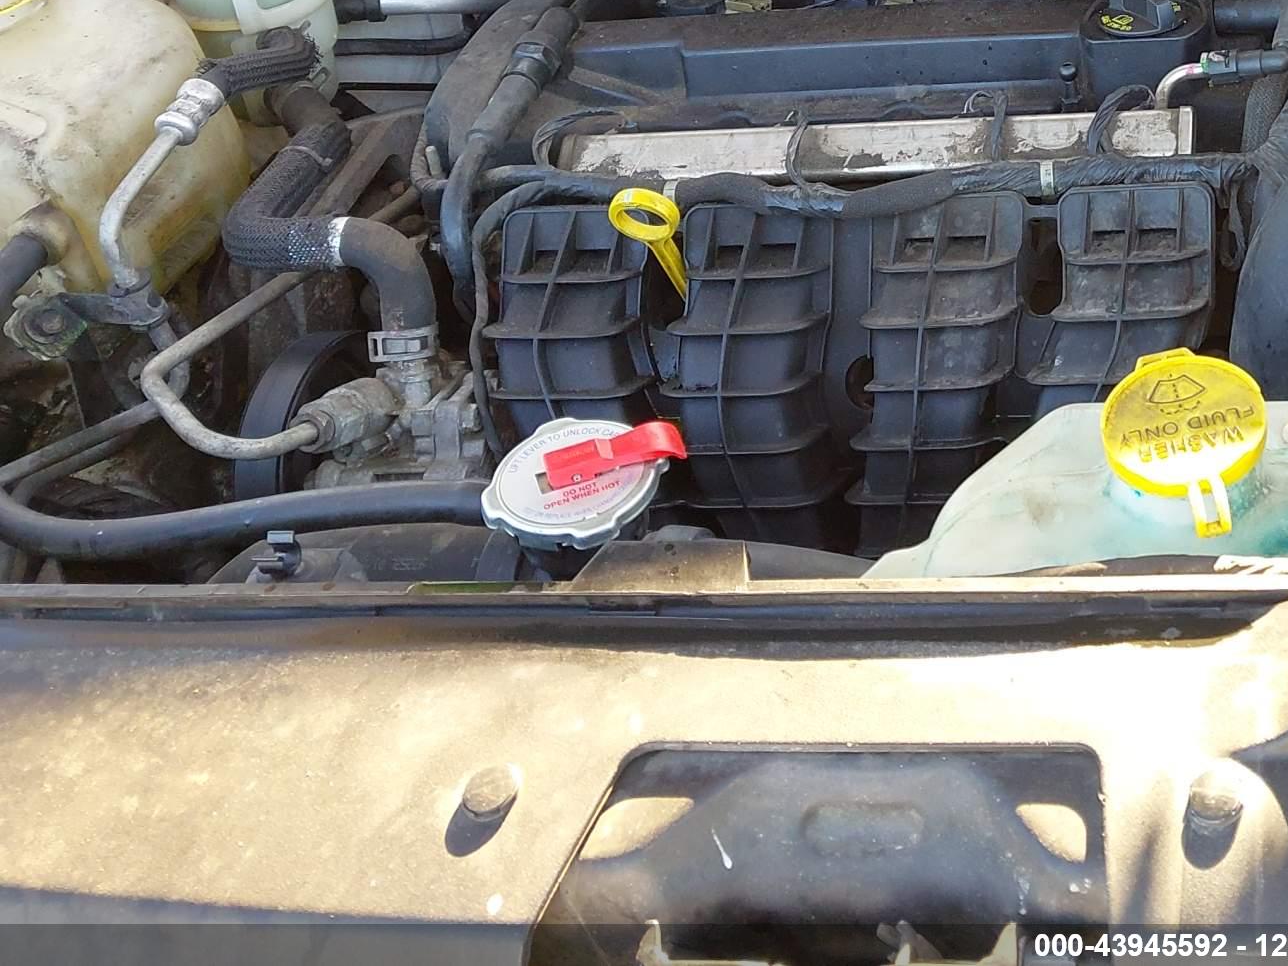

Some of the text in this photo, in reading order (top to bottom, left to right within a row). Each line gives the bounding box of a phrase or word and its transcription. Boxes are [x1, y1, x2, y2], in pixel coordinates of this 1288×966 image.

[520, 439, 546, 460] LEVER
[548, 433, 560, 444] TO
[562, 426, 600, 439] UNLOCK
[1120, 405, 1254, 449] FLUID ONLY
[543, 497, 570, 511] OPEN
[571, 488, 600, 501] WHEN
[601, 480, 622, 491] HOT
[562, 481, 598, 498] DO NOT
